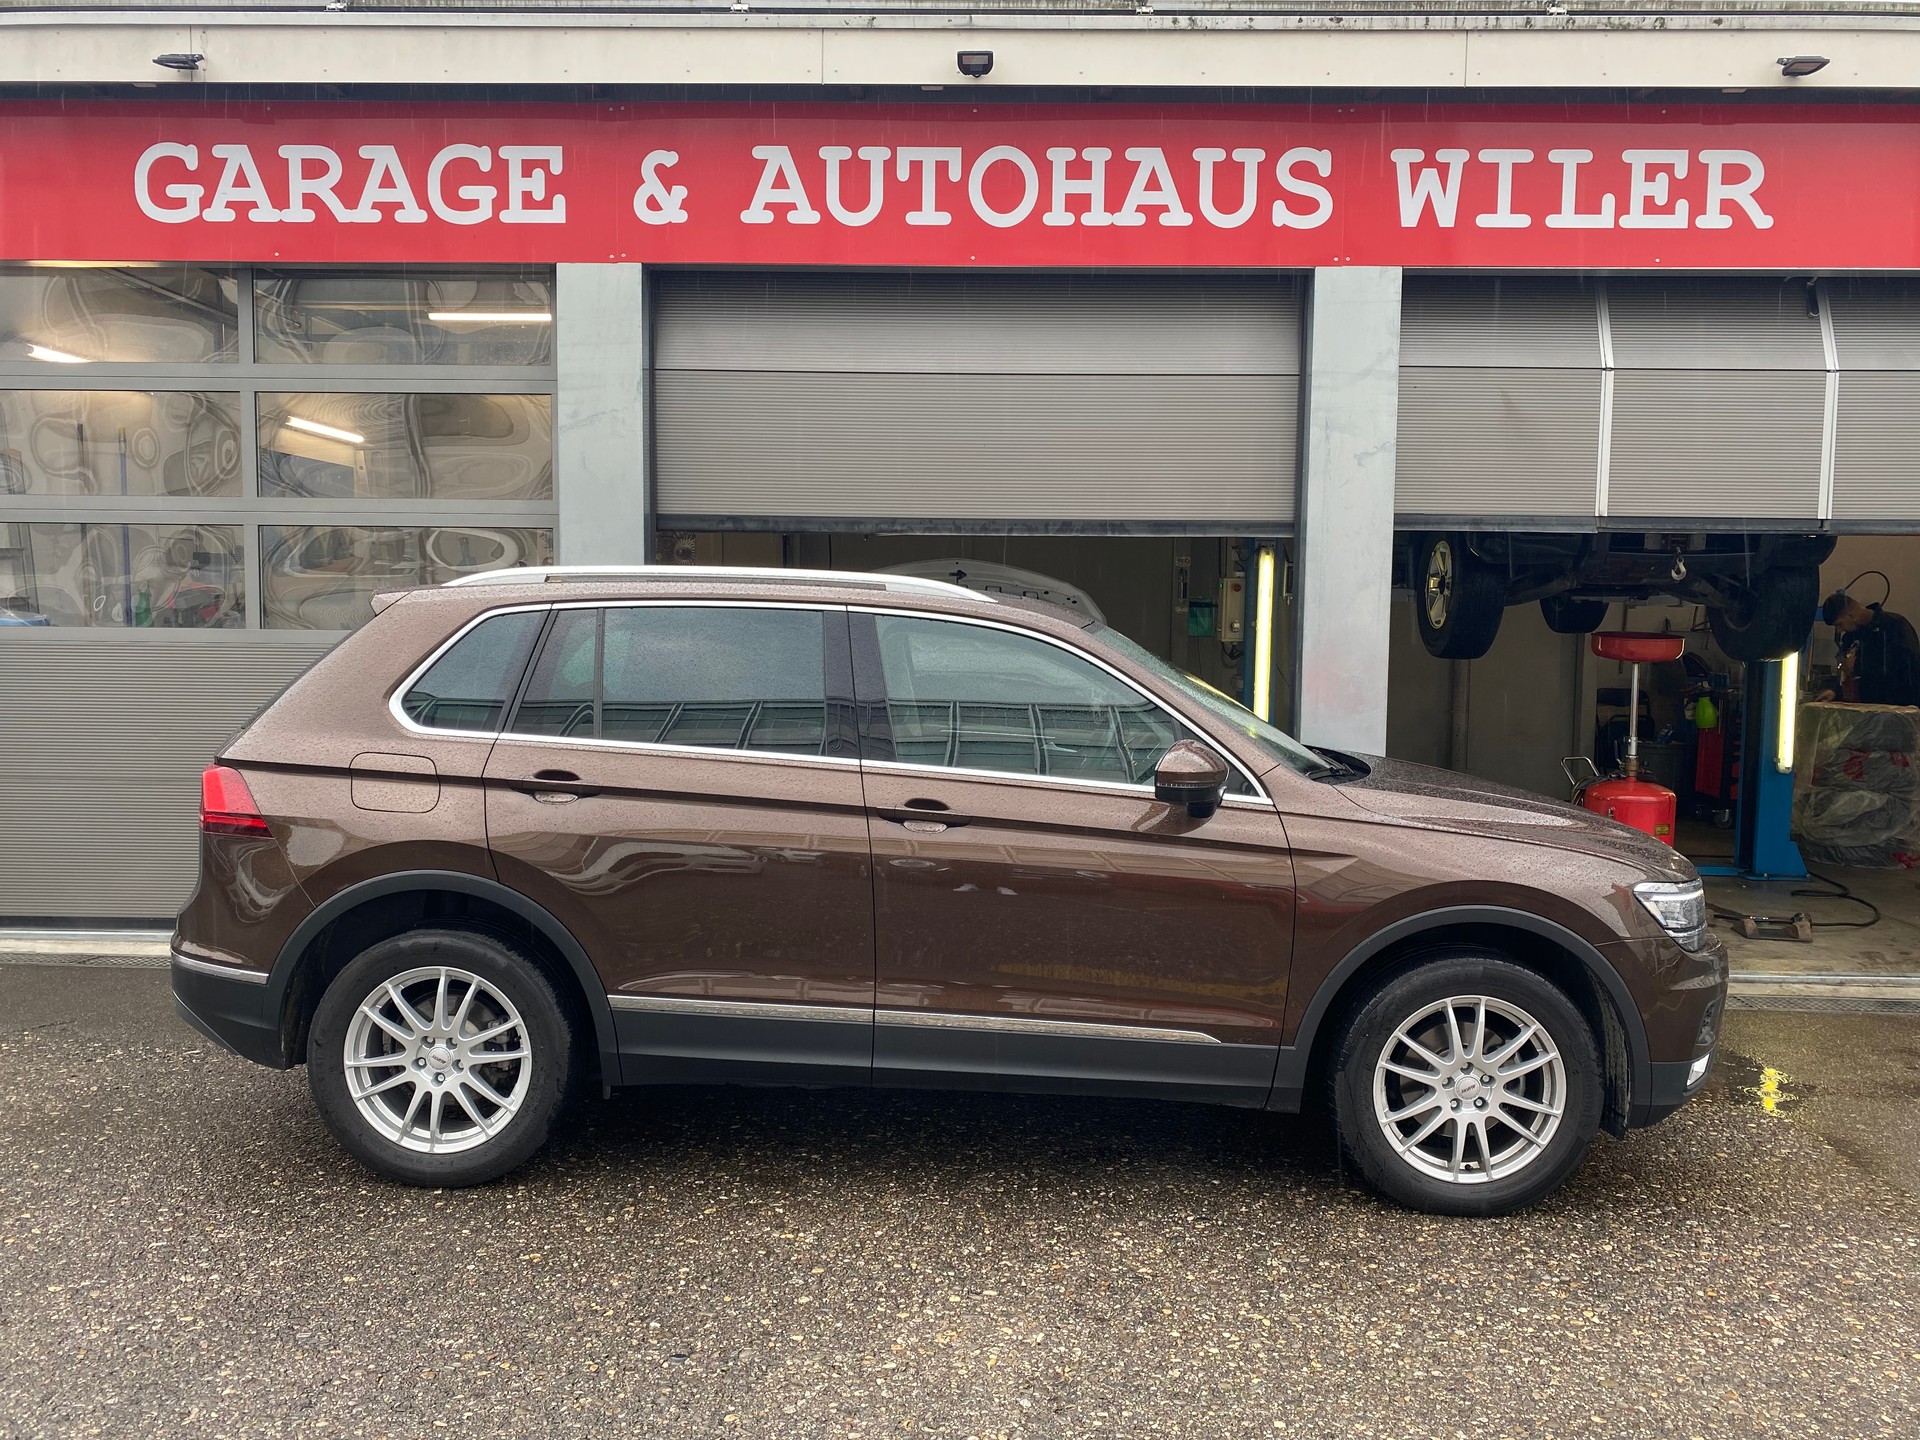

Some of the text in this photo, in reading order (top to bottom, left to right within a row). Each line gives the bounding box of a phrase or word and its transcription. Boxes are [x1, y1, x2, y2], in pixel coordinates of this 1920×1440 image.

[134, 142, 1775, 230] GARAGE & AUTOHAUS WILER
